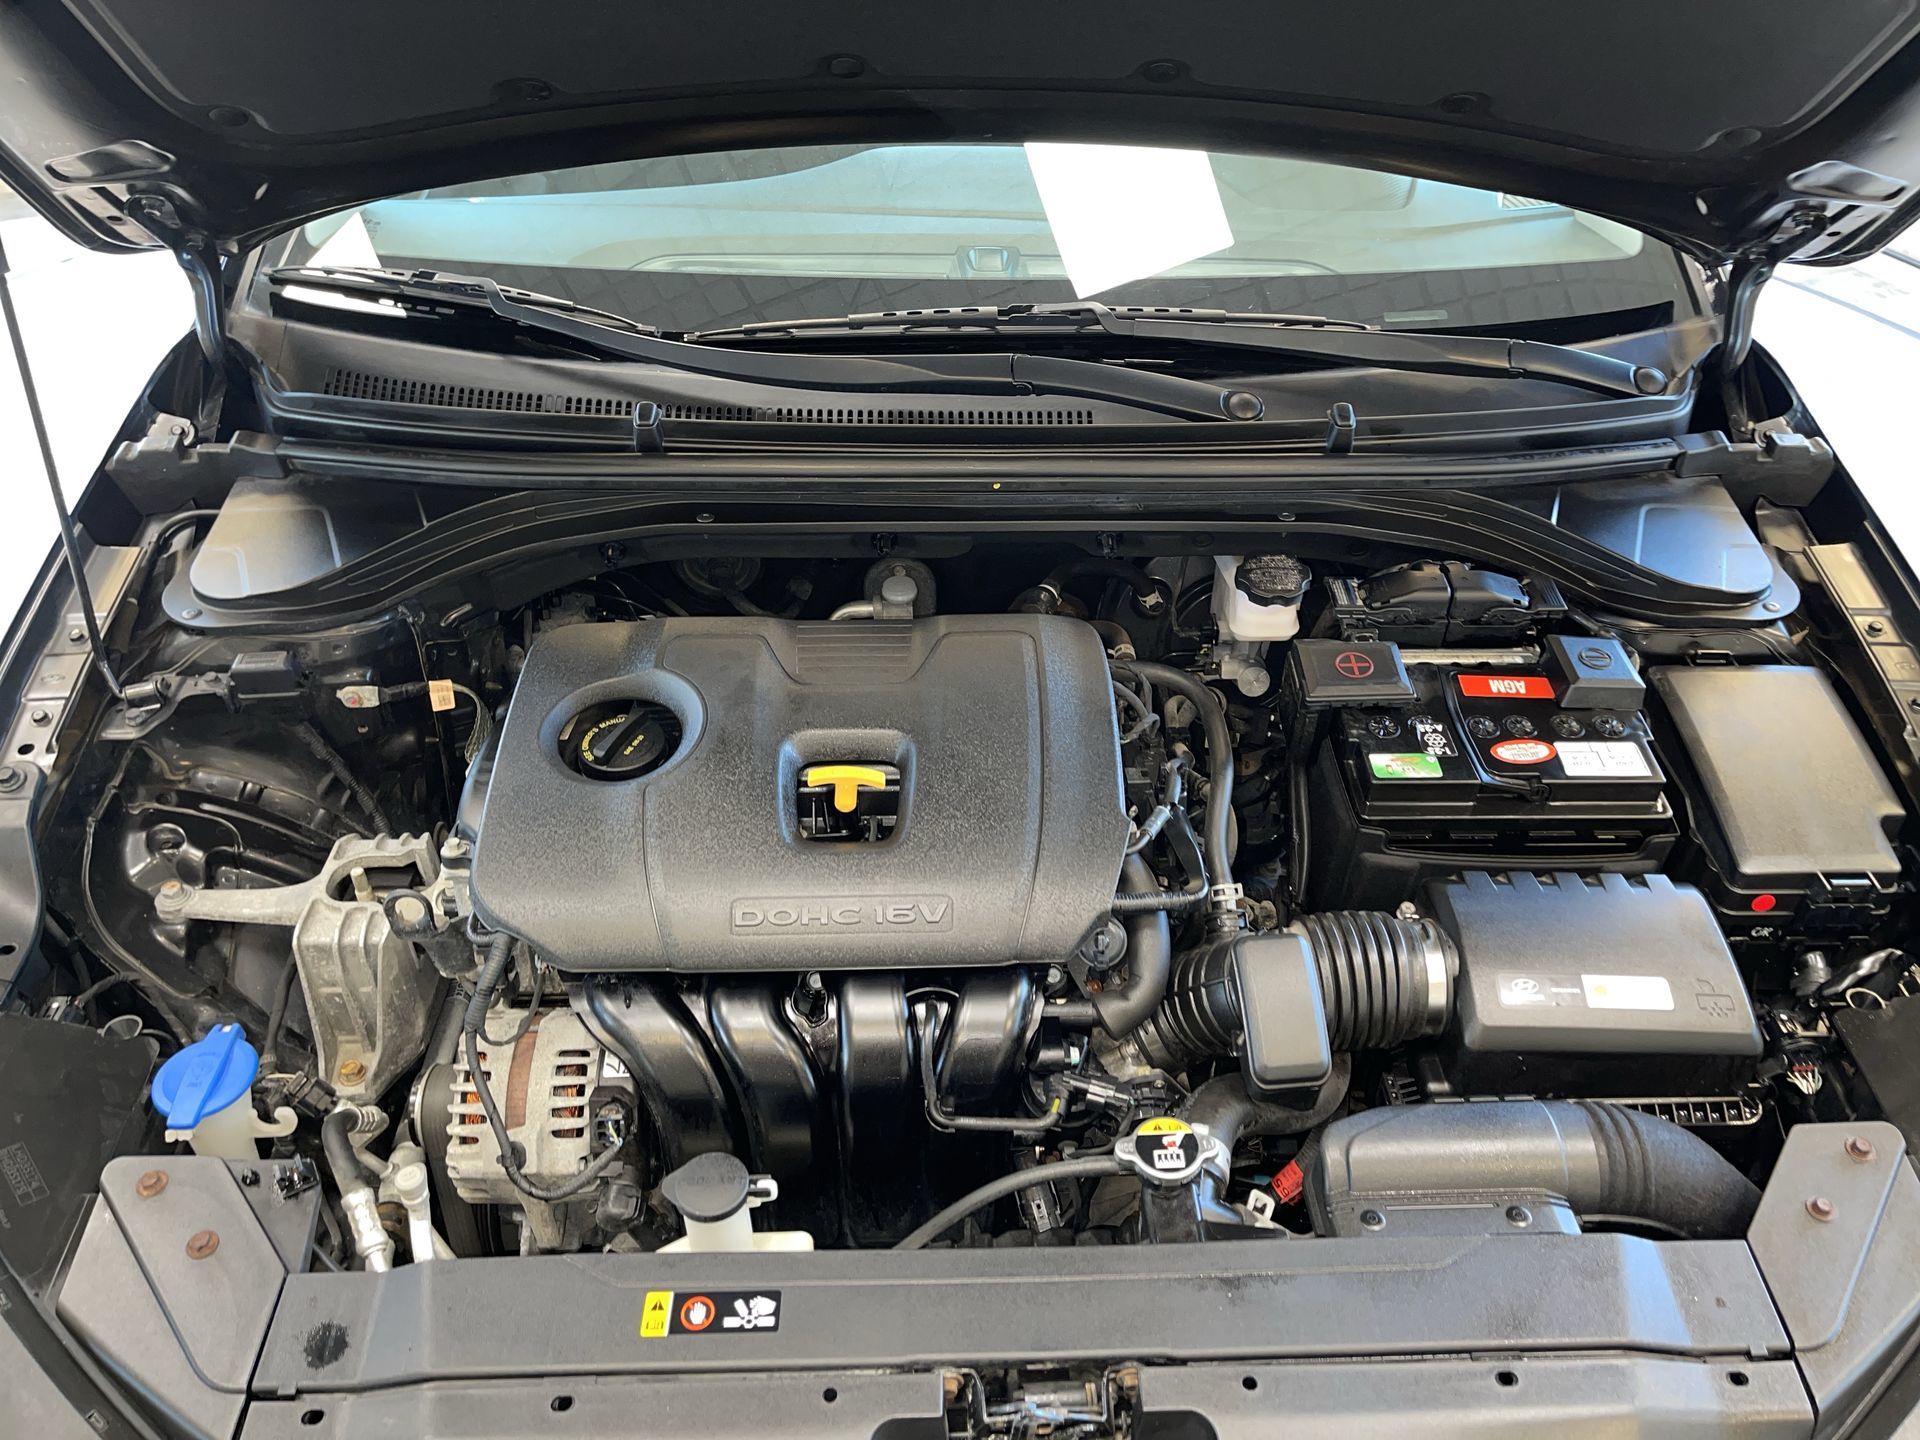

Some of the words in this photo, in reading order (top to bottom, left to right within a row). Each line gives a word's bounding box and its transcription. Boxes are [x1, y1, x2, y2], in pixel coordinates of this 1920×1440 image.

[1488, 679, 1527, 694] AGM
[599, 717, 626, 729] MANUA
[734, 904, 862, 928] DOHC
[873, 902, 949, 925] 16V
